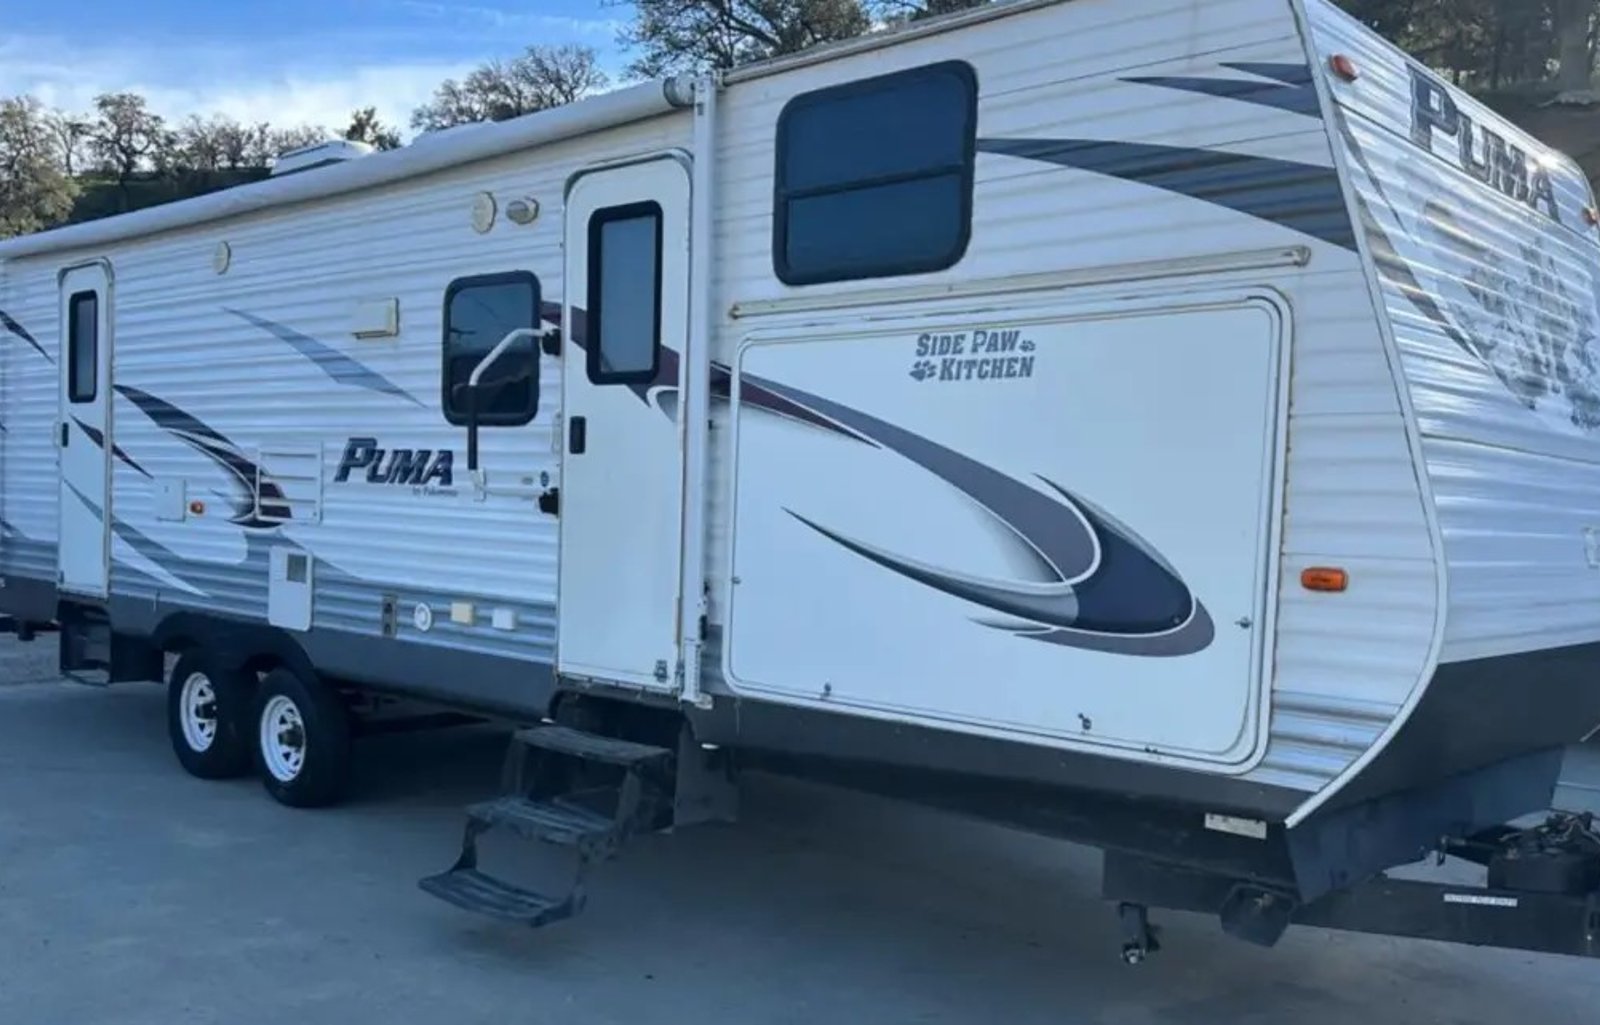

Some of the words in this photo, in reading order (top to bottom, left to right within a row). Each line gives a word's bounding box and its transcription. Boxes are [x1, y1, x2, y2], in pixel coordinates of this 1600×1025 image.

[1405, 62, 1562, 225] PUMA
[916, 333, 966, 356] SIDE
[970, 330, 1020, 354] PAW
[939, 356, 1035, 381] KITCHEN
[333, 436, 454, 486] PUMA
